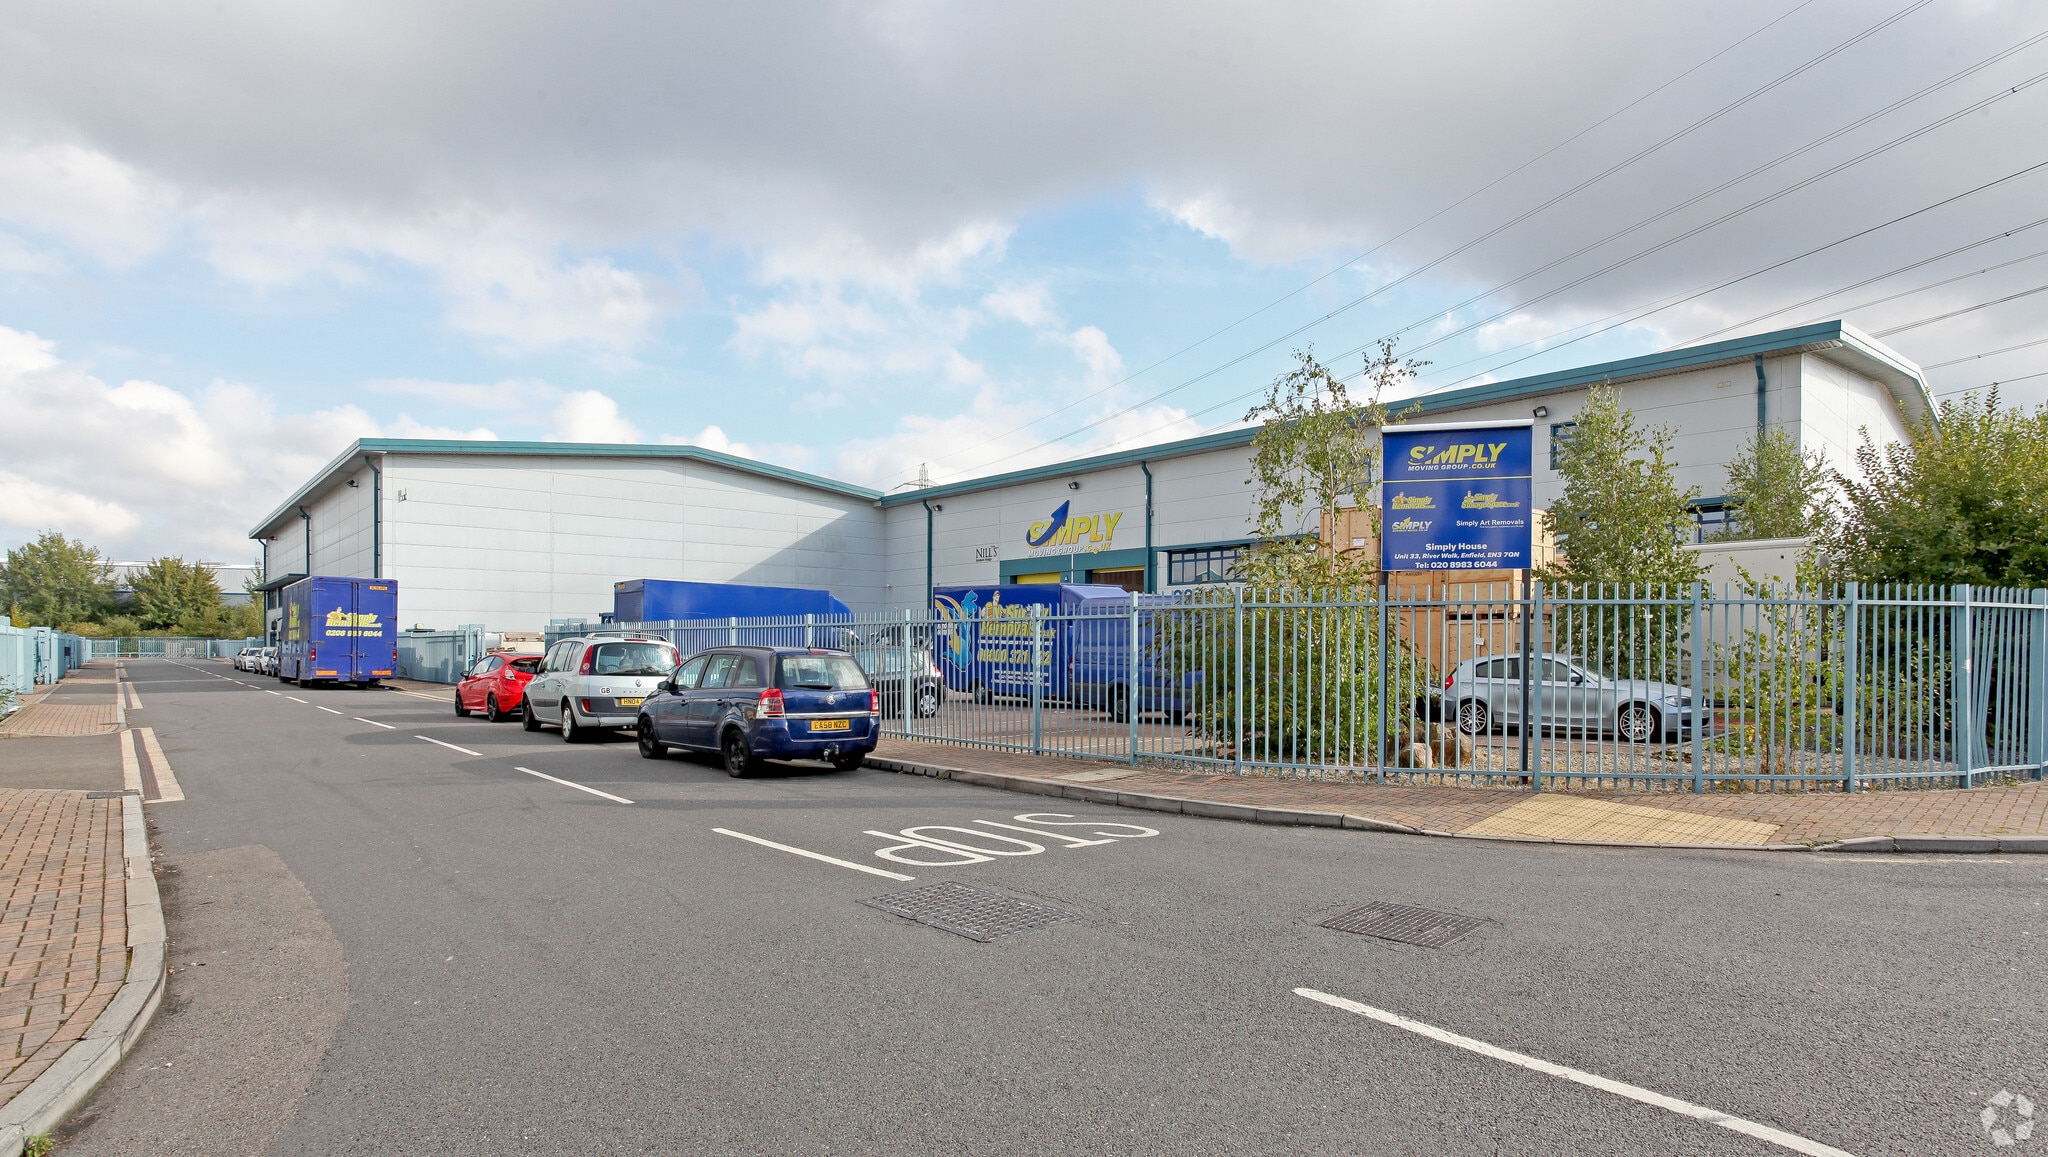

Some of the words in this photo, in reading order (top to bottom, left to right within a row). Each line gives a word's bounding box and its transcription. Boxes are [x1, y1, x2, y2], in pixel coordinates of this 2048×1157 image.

[1408, 442, 1507, 466] SIMPLY
[1028, 512, 1122, 548] SIMPLY
[1391, 521, 1432, 531] SIMPLY
[1425, 544, 1456, 552] Simply
[1458, 542, 1488, 550] House
[1028, 548, 1057, 557] MOVING
[1441, 551, 1460, 559] Walk,
[1461, 551, 1486, 559] Enfield,
[1430, 561, 1449, 569] 020
[1474, 560, 1498, 568] 6044
[833, 720, 847, 728] NZC
[863, 813, 1160, 867] STOP
